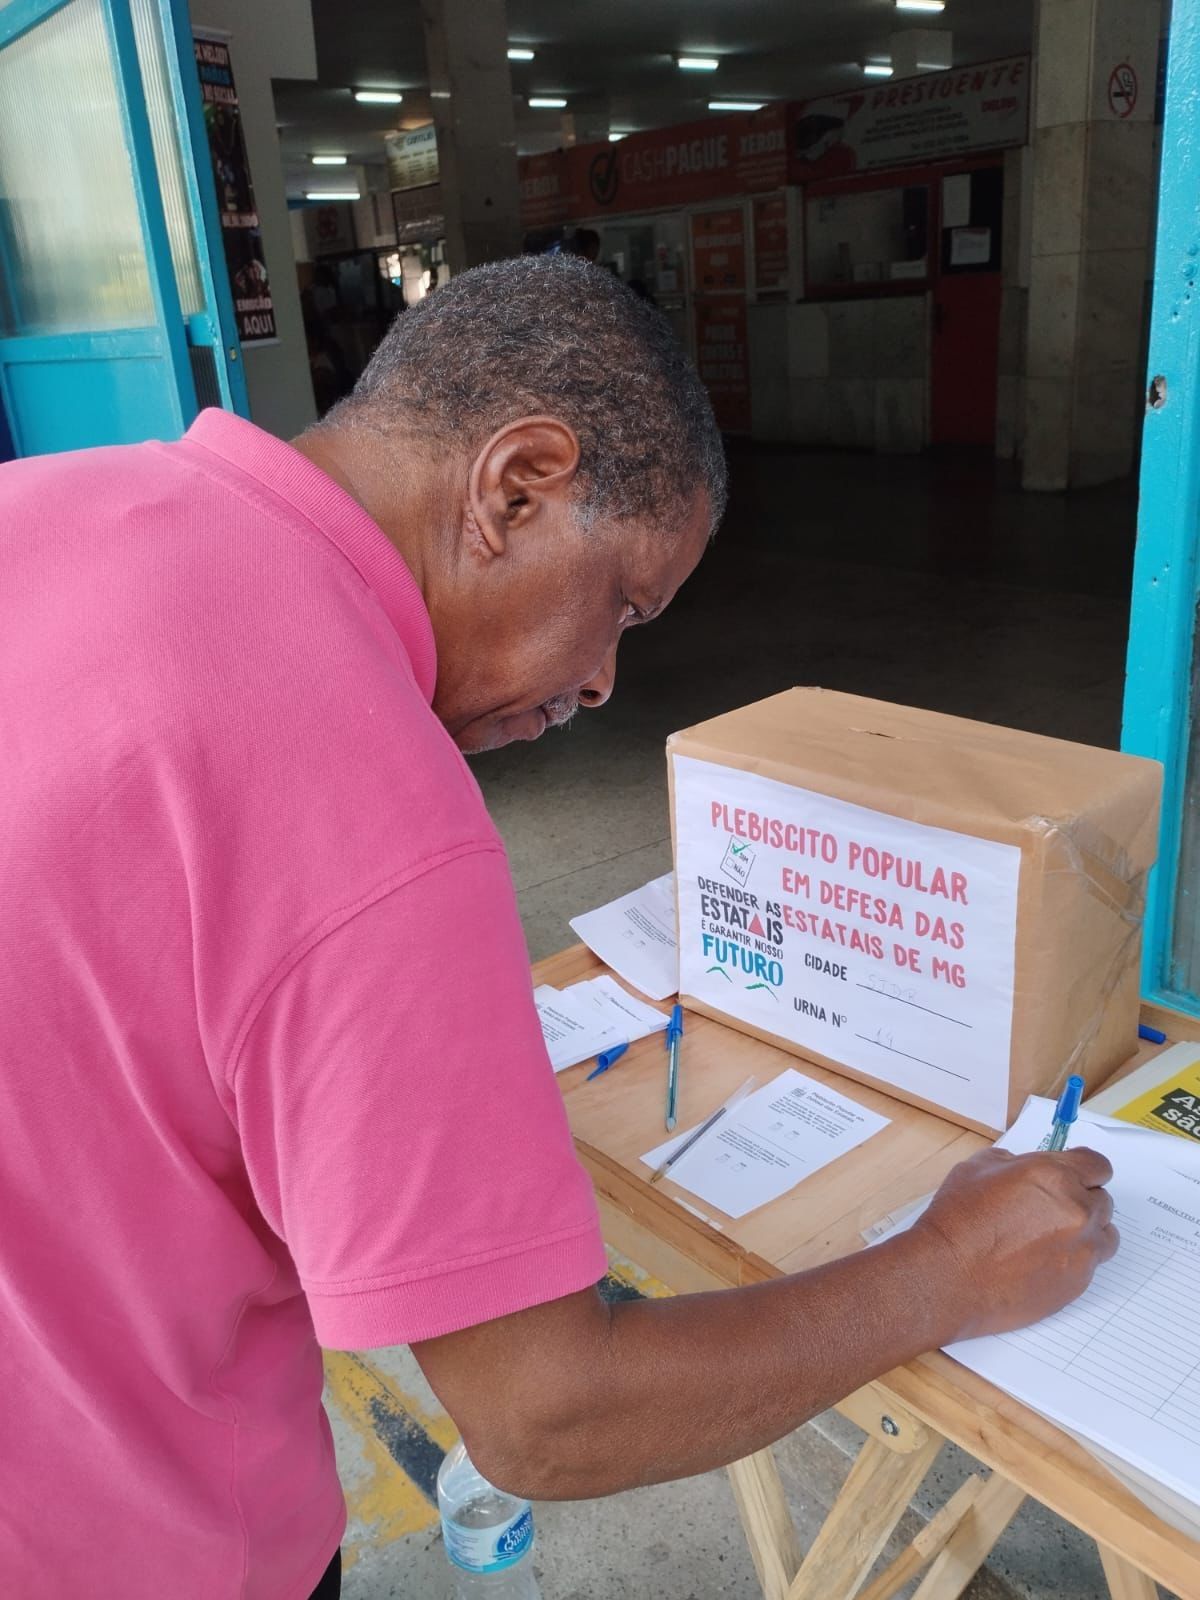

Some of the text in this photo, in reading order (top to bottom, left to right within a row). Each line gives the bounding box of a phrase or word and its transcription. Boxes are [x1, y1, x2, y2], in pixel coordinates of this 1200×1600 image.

[871, 62, 1024, 110] PRESIDENTE
[244, 314, 274, 336] AQUI
[711, 801, 969, 906] PLEBISCITO POPULAR
[733, 863, 746, 878] NÃO
[698, 876, 782, 918] DEFENDER AS
[782, 867, 965, 951] EM DEFESA DAS
[702, 933, 784, 987] FUTURO
[709, 922, 751, 946] GARANTIR
[754, 939, 784, 960] NOSSO
[782, 905, 967, 988] ESTATAIS DE MG
[804, 953, 848, 981] CIDADE
[793, 997, 827, 1022] URNA
